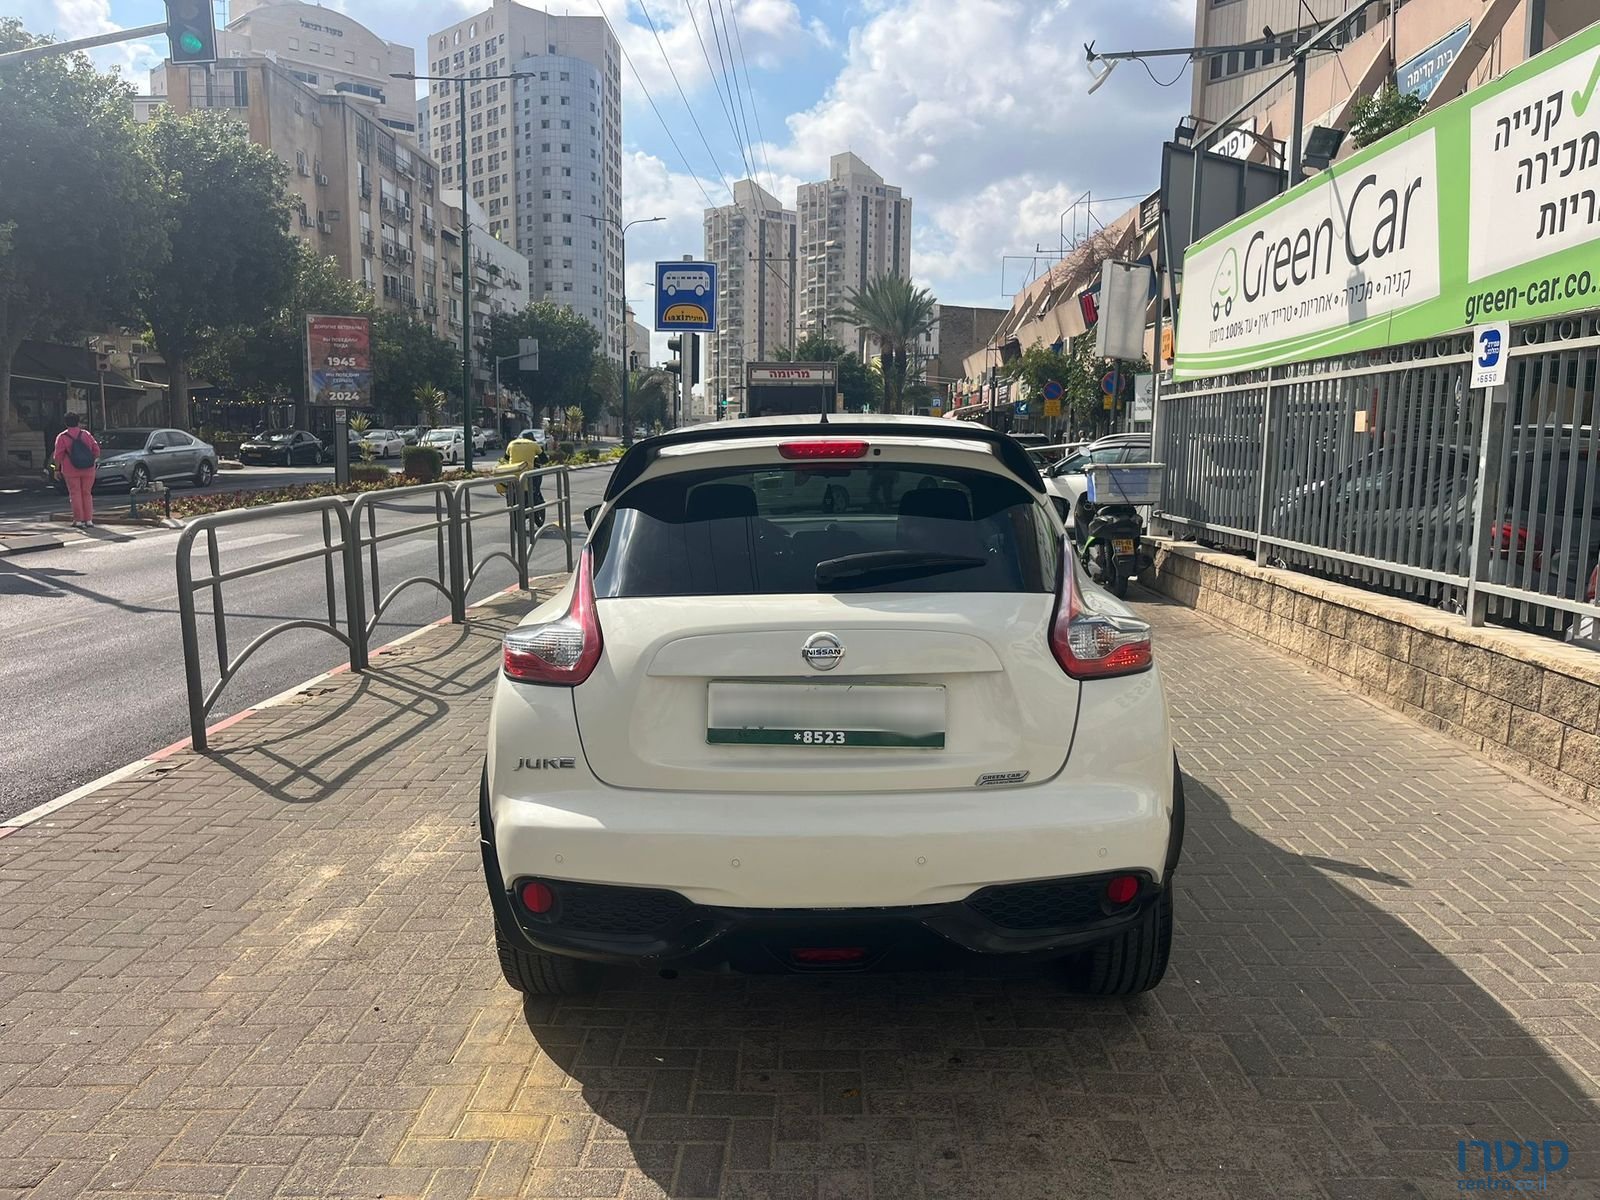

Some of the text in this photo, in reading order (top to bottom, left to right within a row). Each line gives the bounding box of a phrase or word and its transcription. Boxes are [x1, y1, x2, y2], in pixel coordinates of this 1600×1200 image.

[1407, 50, 1453, 88] בית קדימה
[1494, 90, 1564, 151] קנייה
[1516, 130, 1600, 193] מכירה
[1536, 189, 1600, 239] ריות
[1243, 174, 1422, 303] Green Car
[1341, 281, 1373, 307] מכירה
[1383, 269, 1411, 298] קניה
[1299, 292, 1333, 319] אחריות
[1465, 271, 1600, 324] green-car.co.
[1245, 318, 1254, 334] עד
[1258, 312, 1270, 335] אין
[1271, 305, 1293, 325] טרייד
[1225, 321, 1244, 339] 100%
[327, 357, 356, 366] 1945
[329, 392, 360, 400] 2024
[512, 756, 576, 771] JUKE
